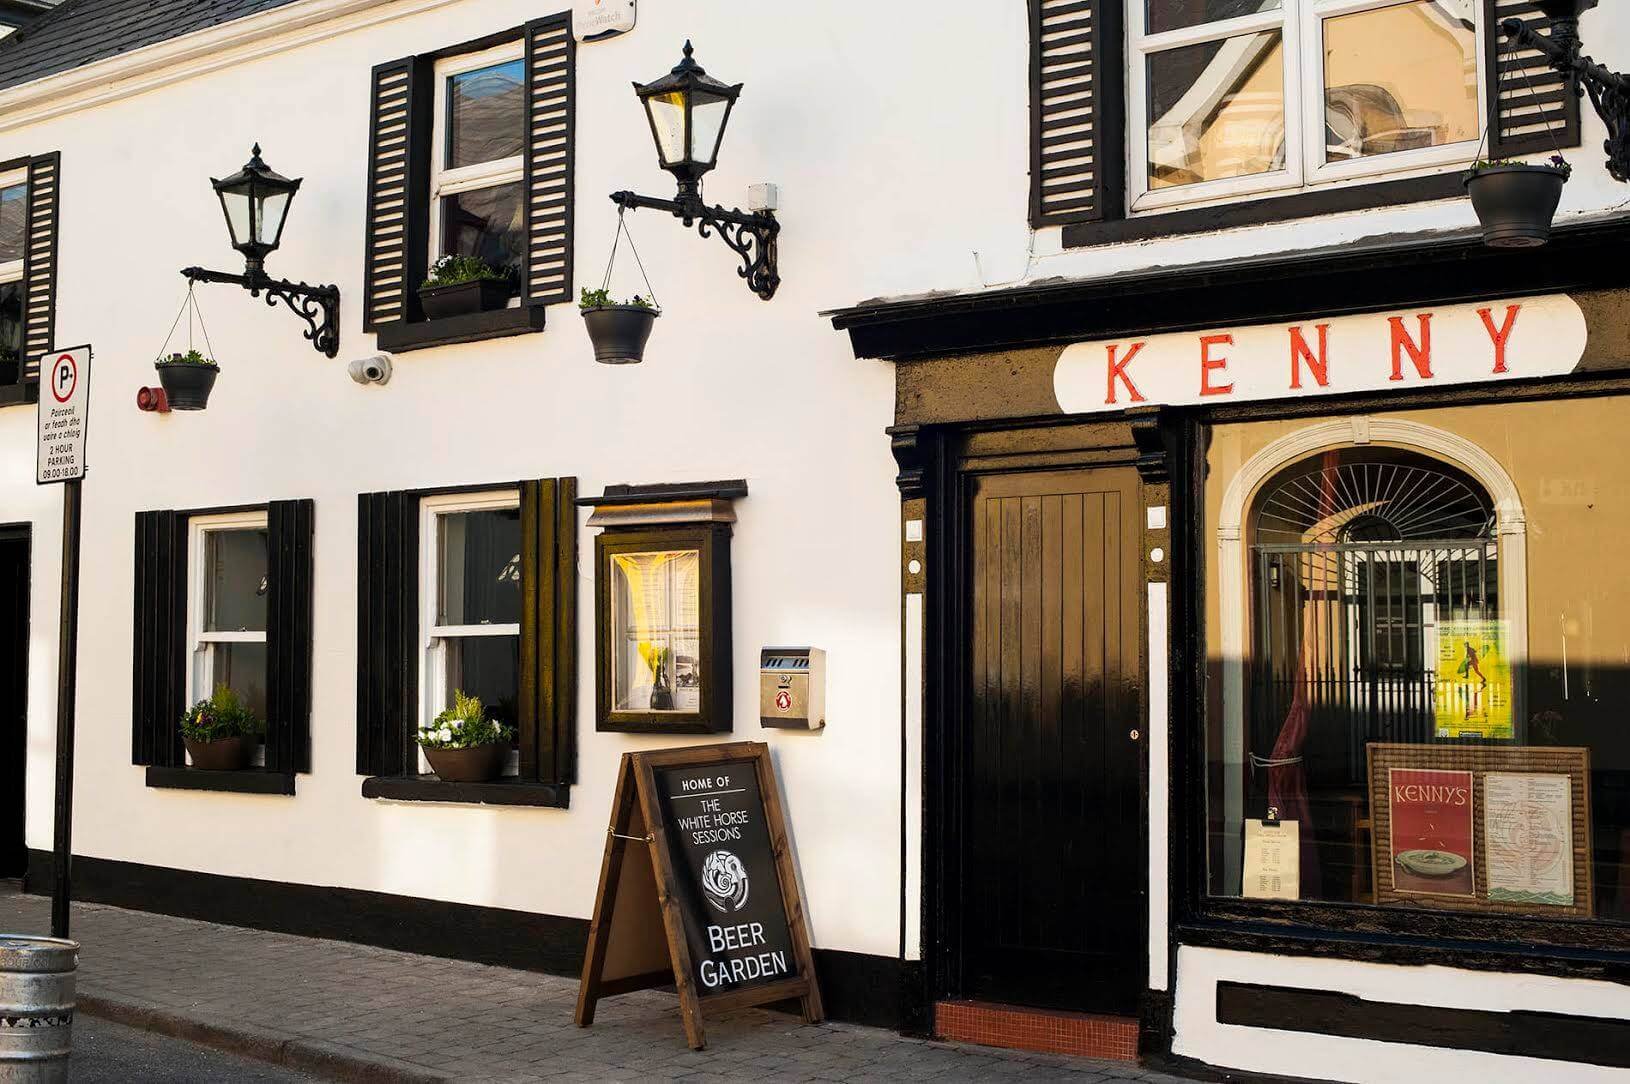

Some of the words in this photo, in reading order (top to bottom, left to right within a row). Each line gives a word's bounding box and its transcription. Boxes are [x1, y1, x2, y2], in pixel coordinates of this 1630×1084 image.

[1104, 304, 1521, 405] KENNY
[55, 443, 73, 453] HOUR
[47, 455, 74, 466] PARKING
[43, 466, 79, 479] 09.00-18.00
[682, 777, 713, 791] HOME
[716, 776, 730, 788] OF
[1395, 785, 1467, 806] KENNY'S
[700, 799, 721, 813] THE
[678, 815, 711, 832] WHITE
[713, 810, 749, 828] HORSE
[692, 826, 742, 845] SESSIONS
[707, 922, 766, 953] BEER
[700, 950, 788, 988] GARDEN
